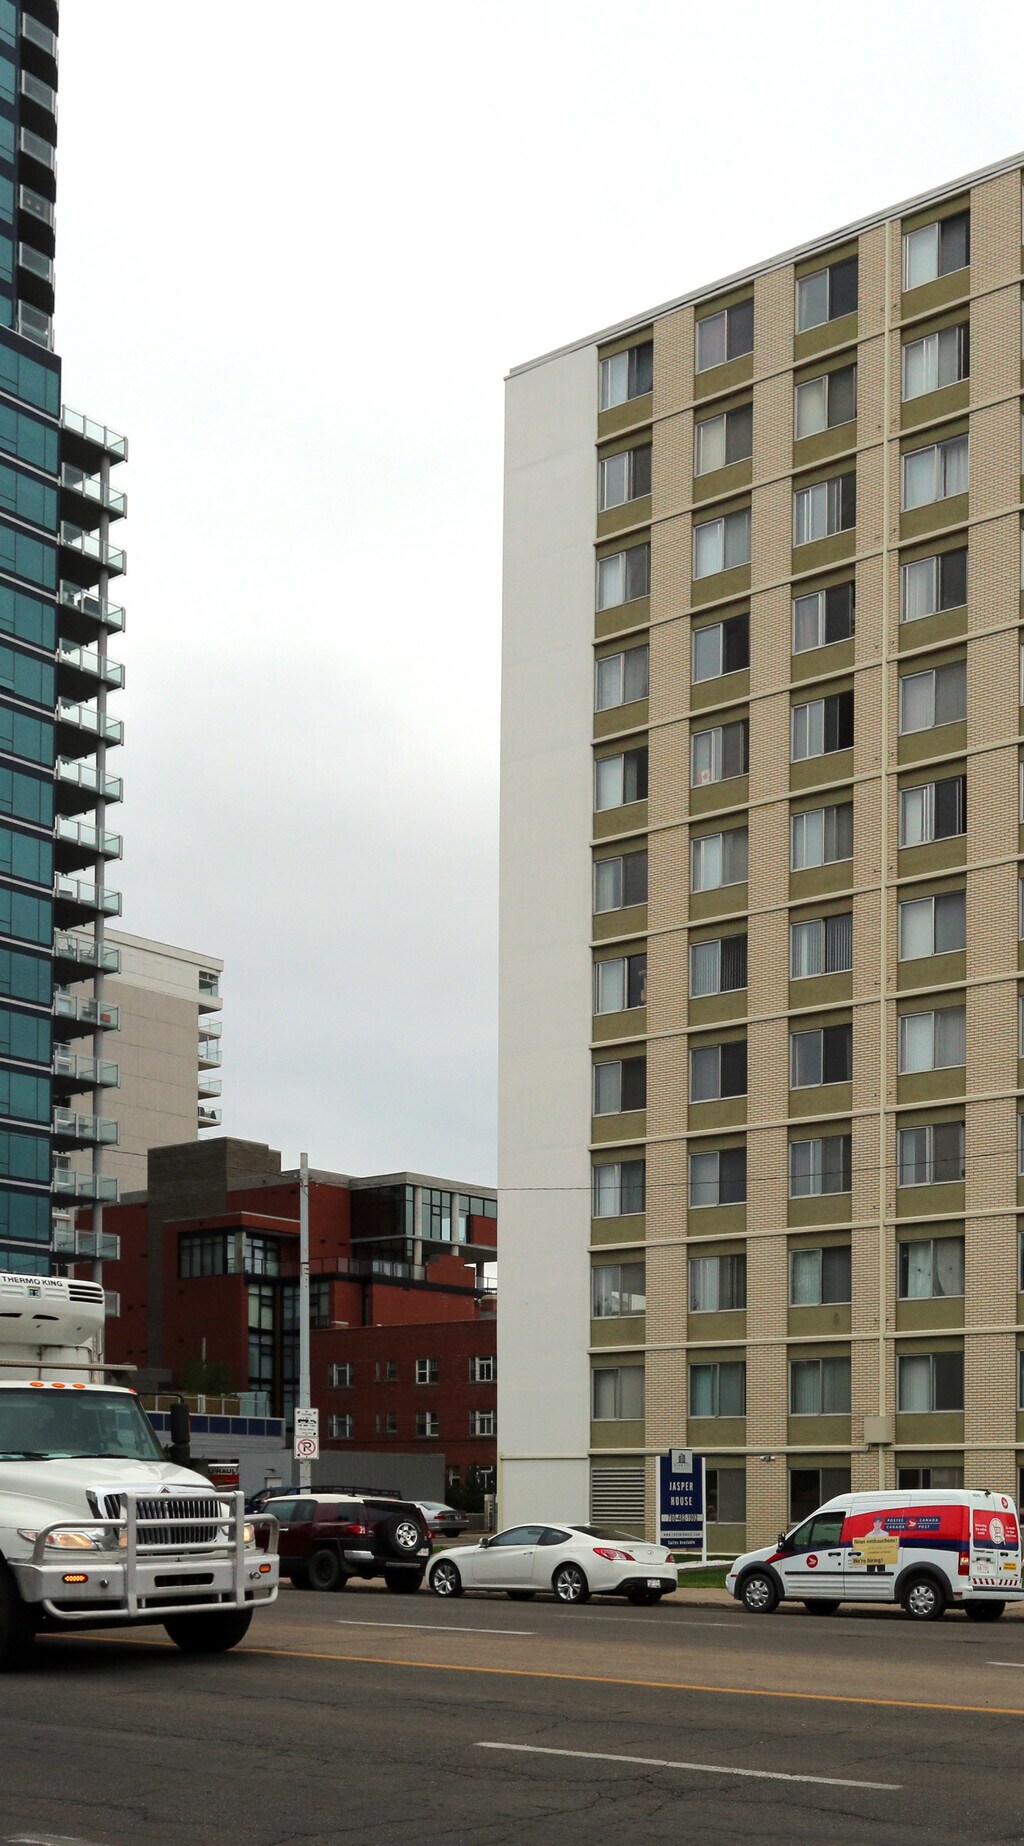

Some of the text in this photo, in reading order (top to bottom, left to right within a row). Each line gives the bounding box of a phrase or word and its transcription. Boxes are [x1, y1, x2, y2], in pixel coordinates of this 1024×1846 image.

[2, 1276, 63, 1287] THERMO KING
[669, 1482, 693, 1490] JASPER
[671, 1497, 693, 1505] HOUSE
